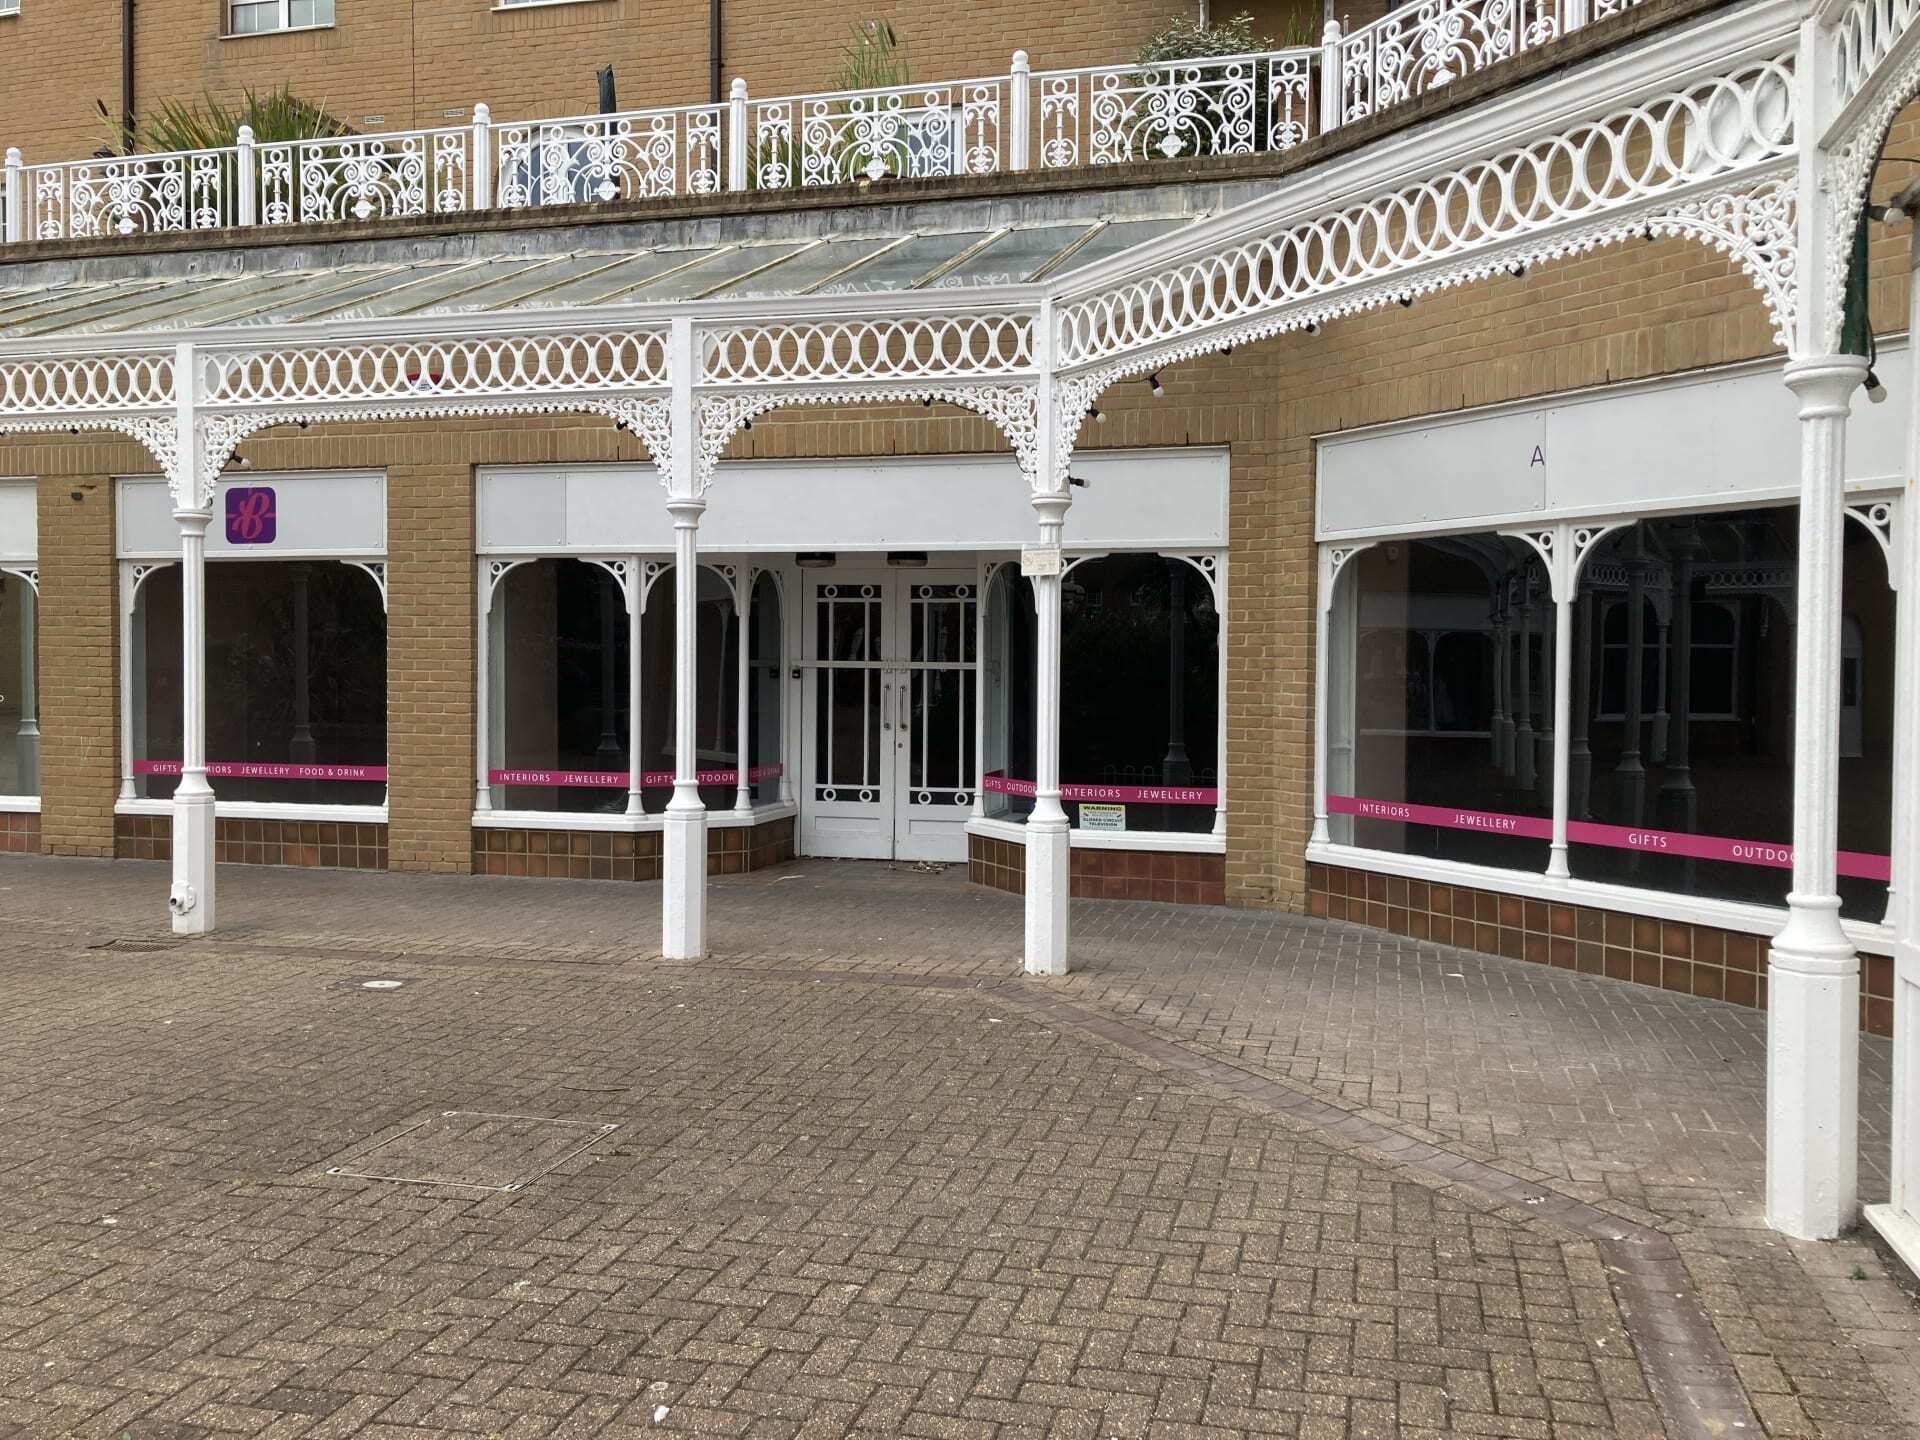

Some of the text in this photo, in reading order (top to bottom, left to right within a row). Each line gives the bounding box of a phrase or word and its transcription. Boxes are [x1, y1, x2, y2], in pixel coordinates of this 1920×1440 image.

[1530, 444, 1545, 467] A
[153, 764, 178, 773] GIFTS
[241, 766, 289, 775] JEWELLERY
[299, 767, 324, 776] FOOD
[327, 768, 334, 776] &
[337, 768, 366, 777] DRINK
[500, 773, 619, 784] INTERIORS JEWELLERY
[645, 775, 675, 784] GIFTS
[985, 779, 1001, 789] GIFTS
[1137, 789, 1203, 800] JEWELLERY
[1358, 803, 1517, 830] INTERIORS JEWELLERY
[1628, 833, 1794, 862] GIFTS OUTDO
